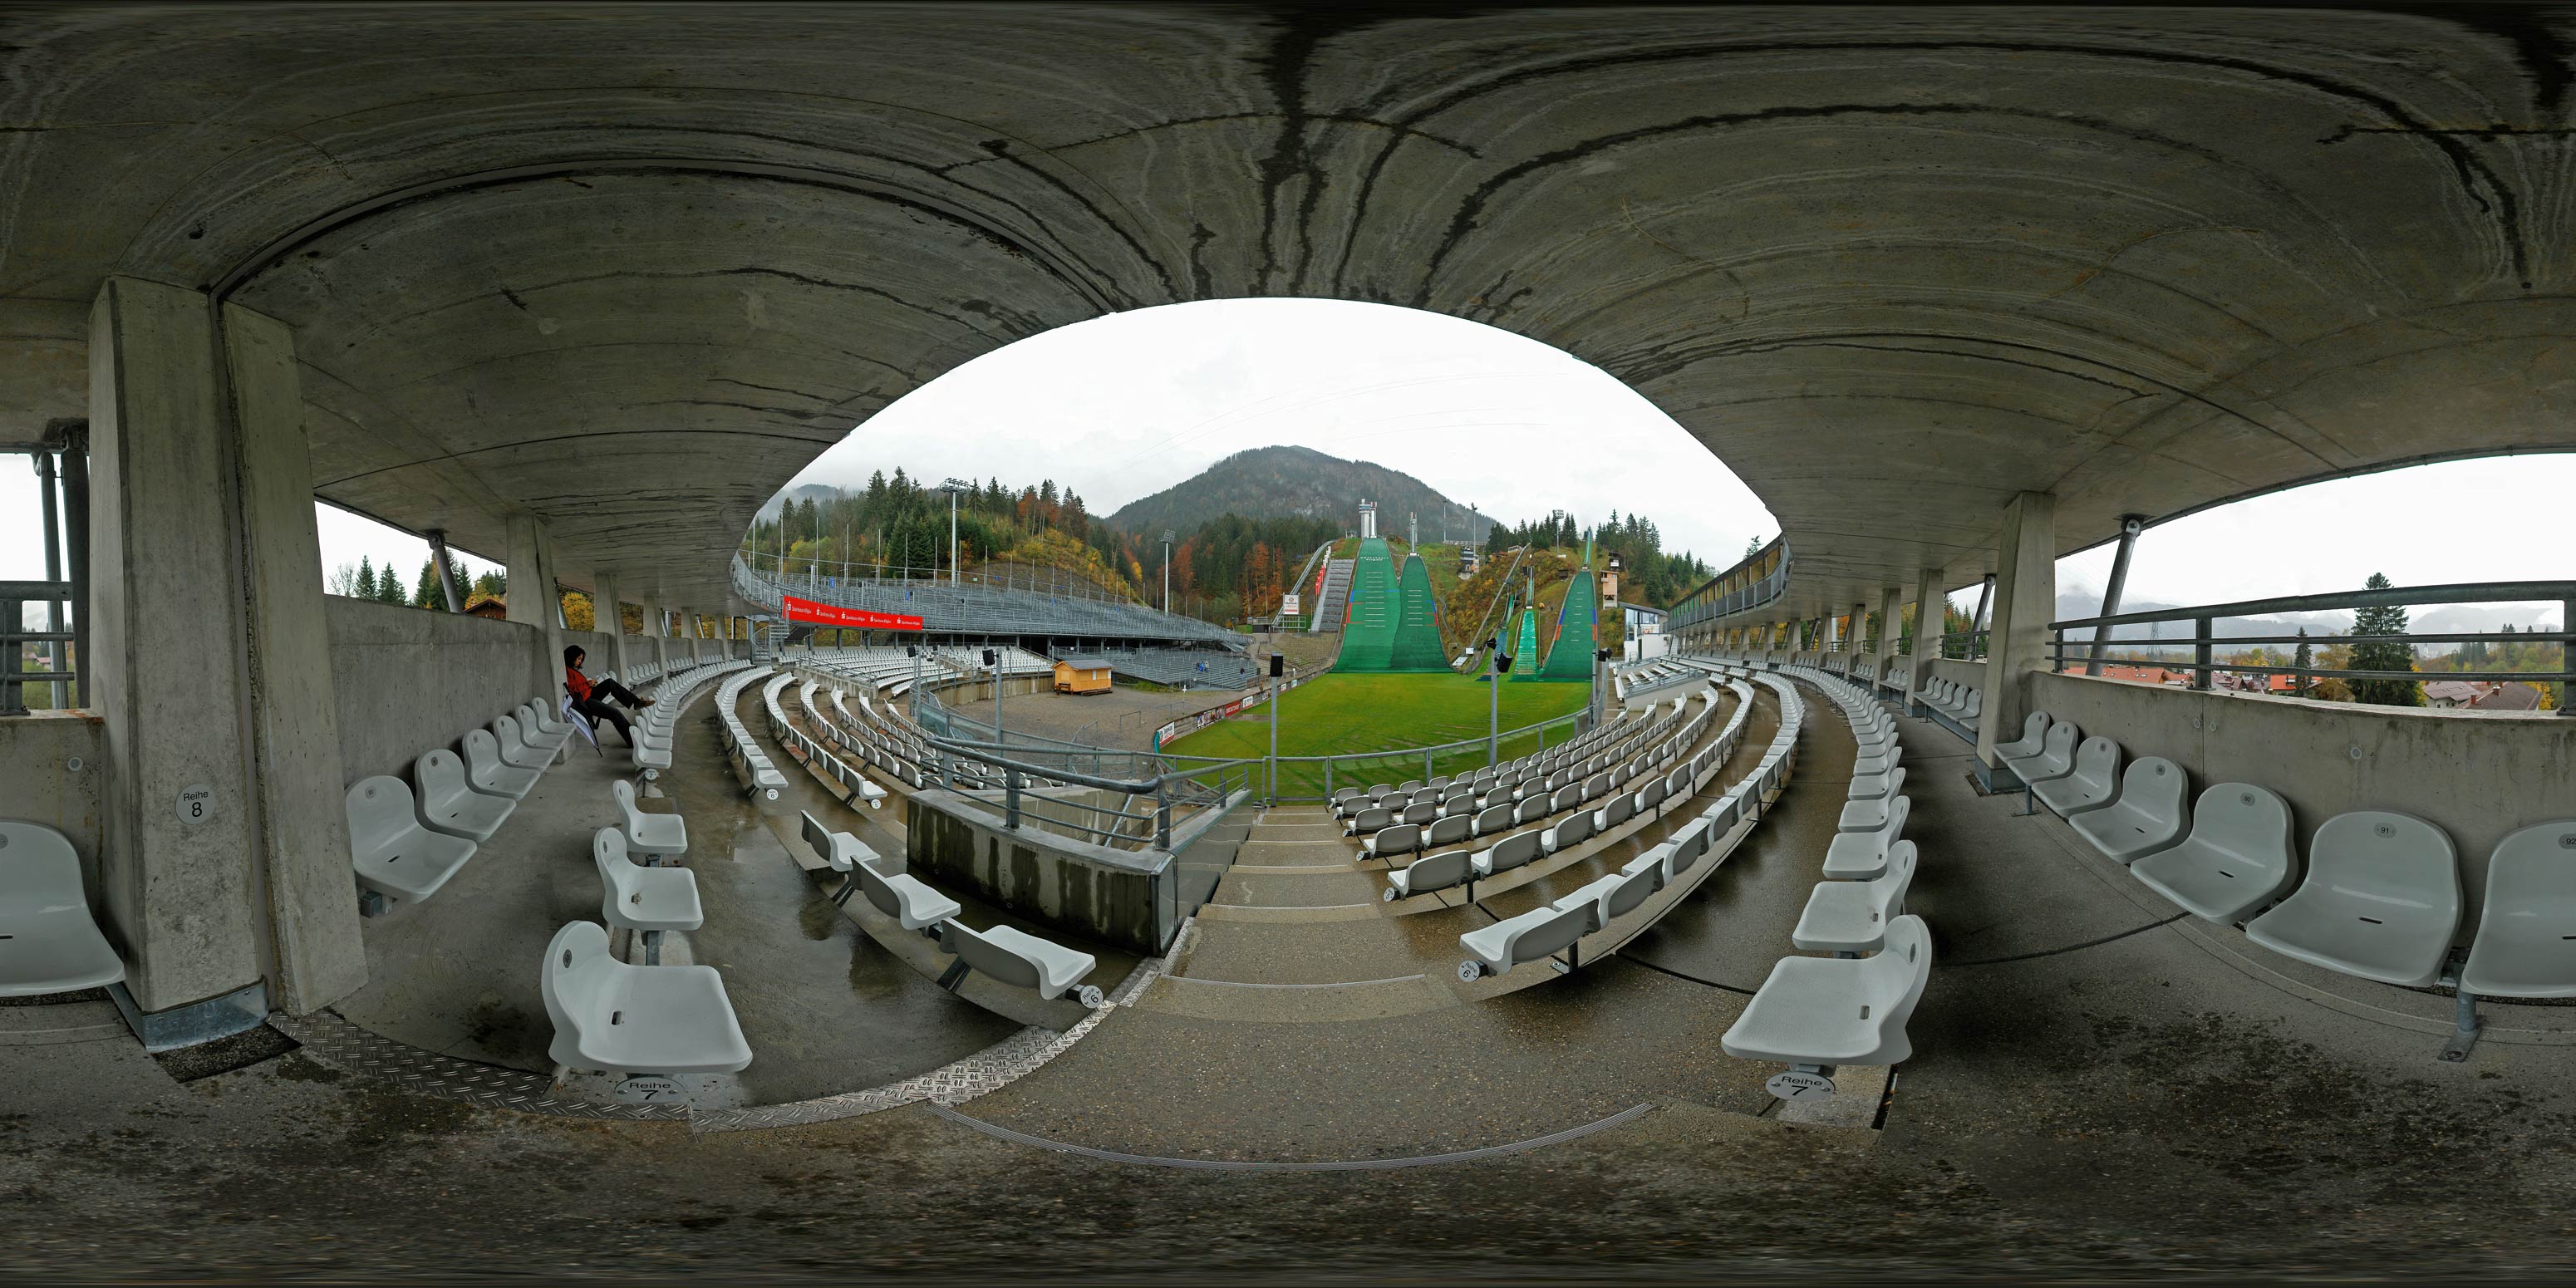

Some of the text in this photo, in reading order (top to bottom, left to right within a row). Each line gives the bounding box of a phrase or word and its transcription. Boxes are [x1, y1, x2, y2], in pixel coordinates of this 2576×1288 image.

[184, 791, 209, 801] Reihe
[192, 802, 202, 817] 8
[1465, 961, 1477, 972] Reihe
[1463, 970, 1471, 978] 6
[1083, 988, 1095, 999] Reihe
[1090, 995, 1099, 1003] 6
[1782, 1075, 1822, 1086] Reihe
[641, 1090, 659, 1100] 7
[1792, 1085, 1809, 1096] 7
